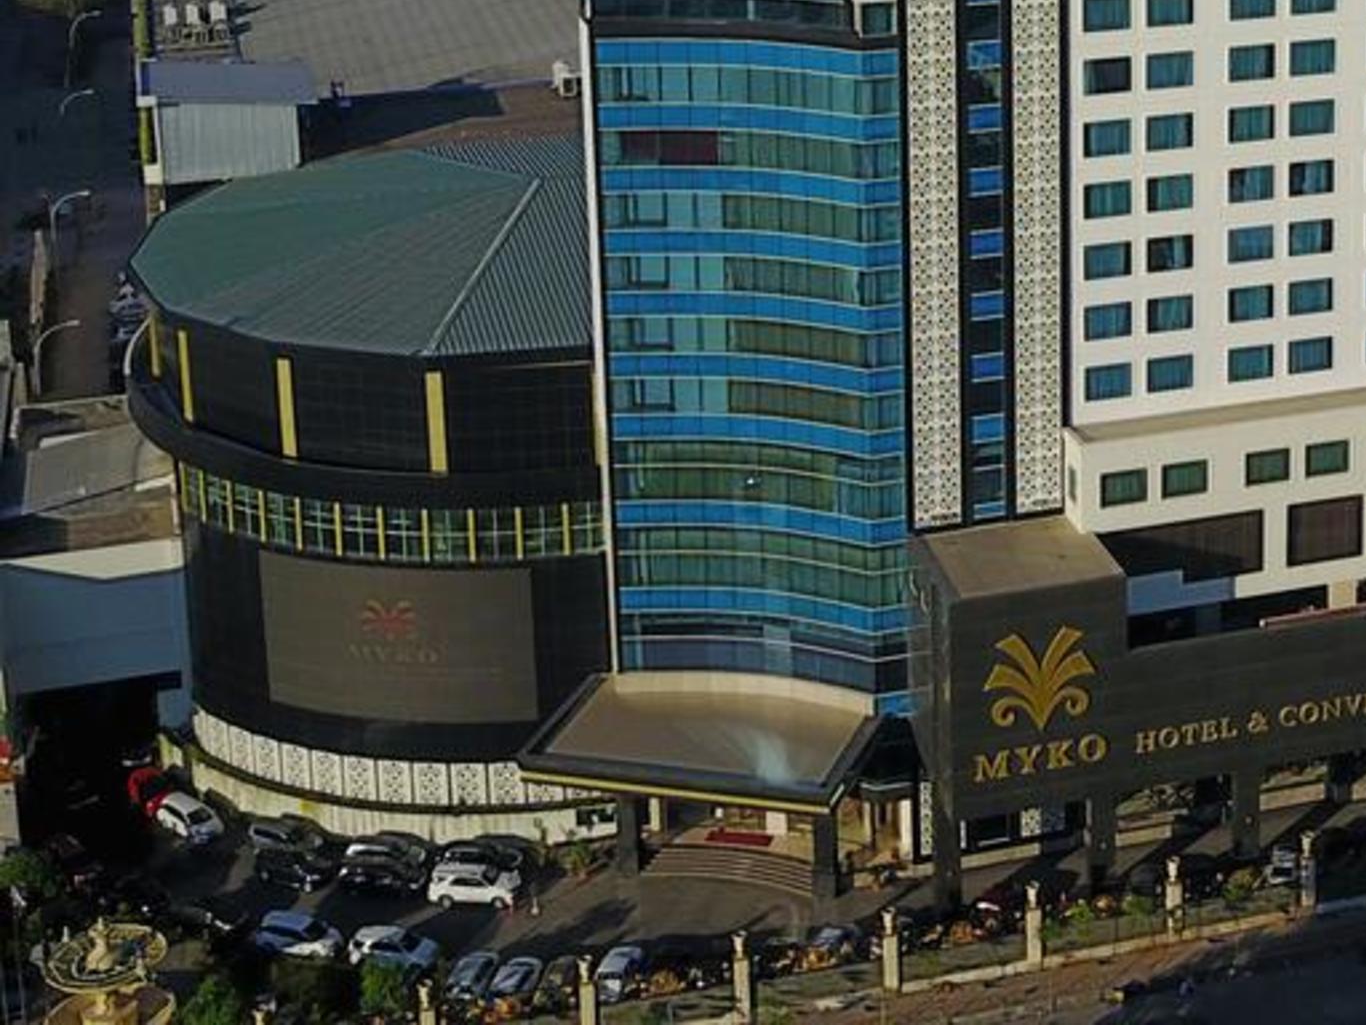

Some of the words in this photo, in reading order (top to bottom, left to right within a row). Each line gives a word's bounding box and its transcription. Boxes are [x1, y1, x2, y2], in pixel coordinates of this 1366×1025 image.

[1135, 716, 1237, 754] HOTEL
[1248, 711, 1269, 733] &
[974, 733, 1107, 783] MYKO
